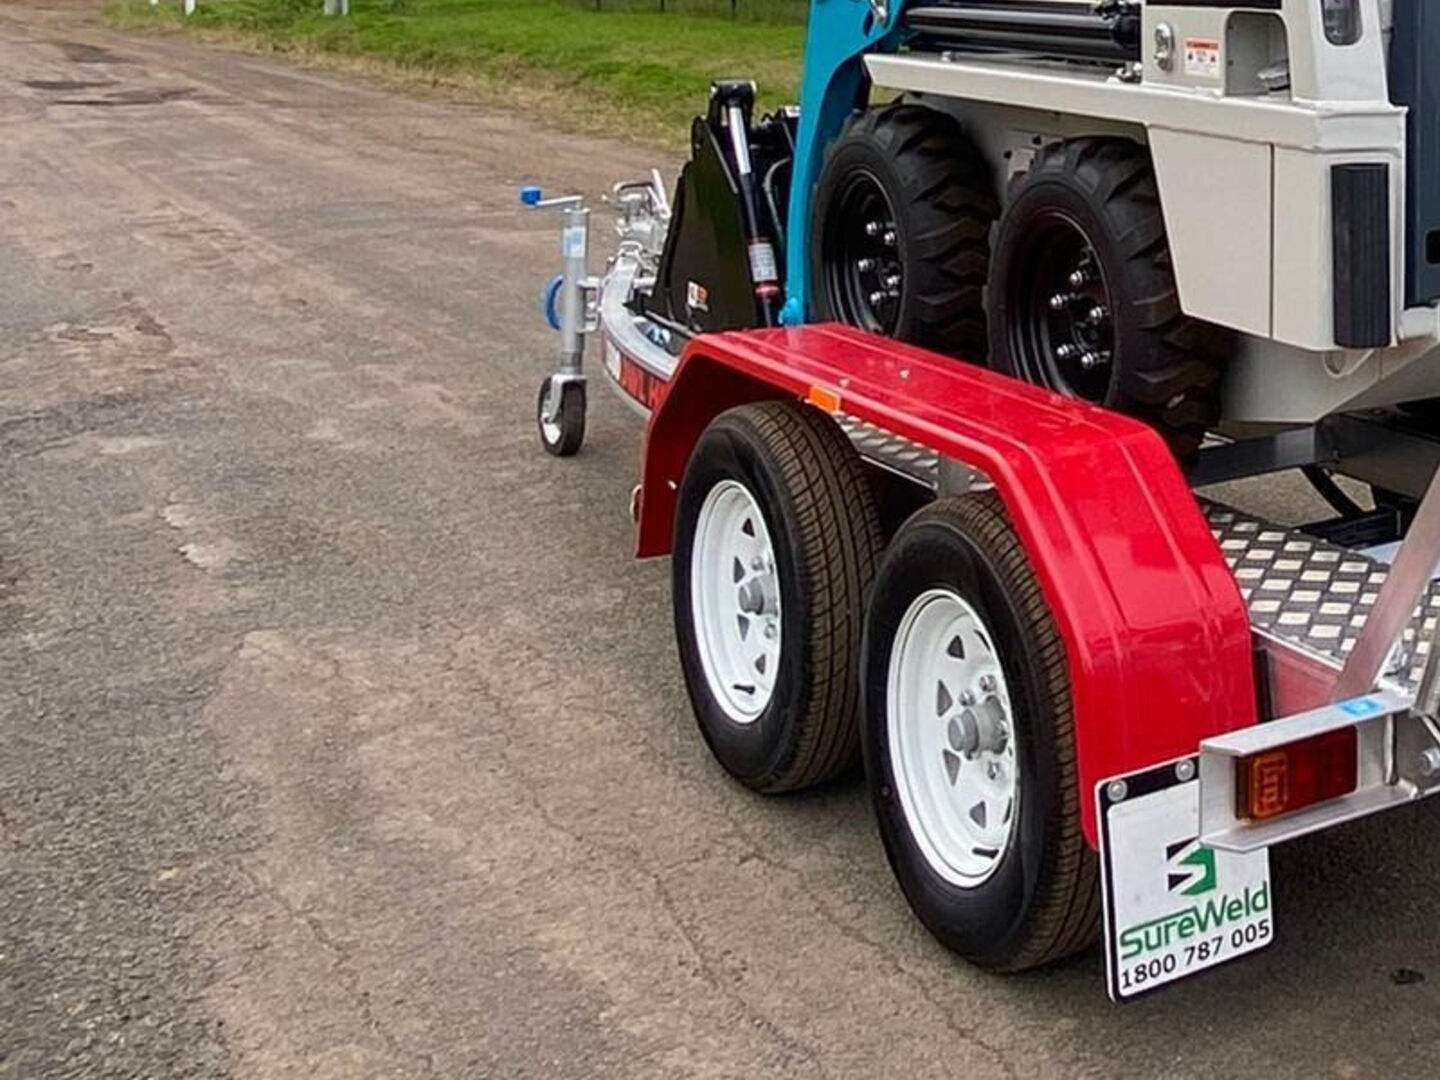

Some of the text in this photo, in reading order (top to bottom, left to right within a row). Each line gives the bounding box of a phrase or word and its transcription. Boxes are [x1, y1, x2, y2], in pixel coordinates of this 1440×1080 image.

[1118, 880, 1269, 960] SureWeld
[1120, 921, 1271, 990] 1800 787 005
